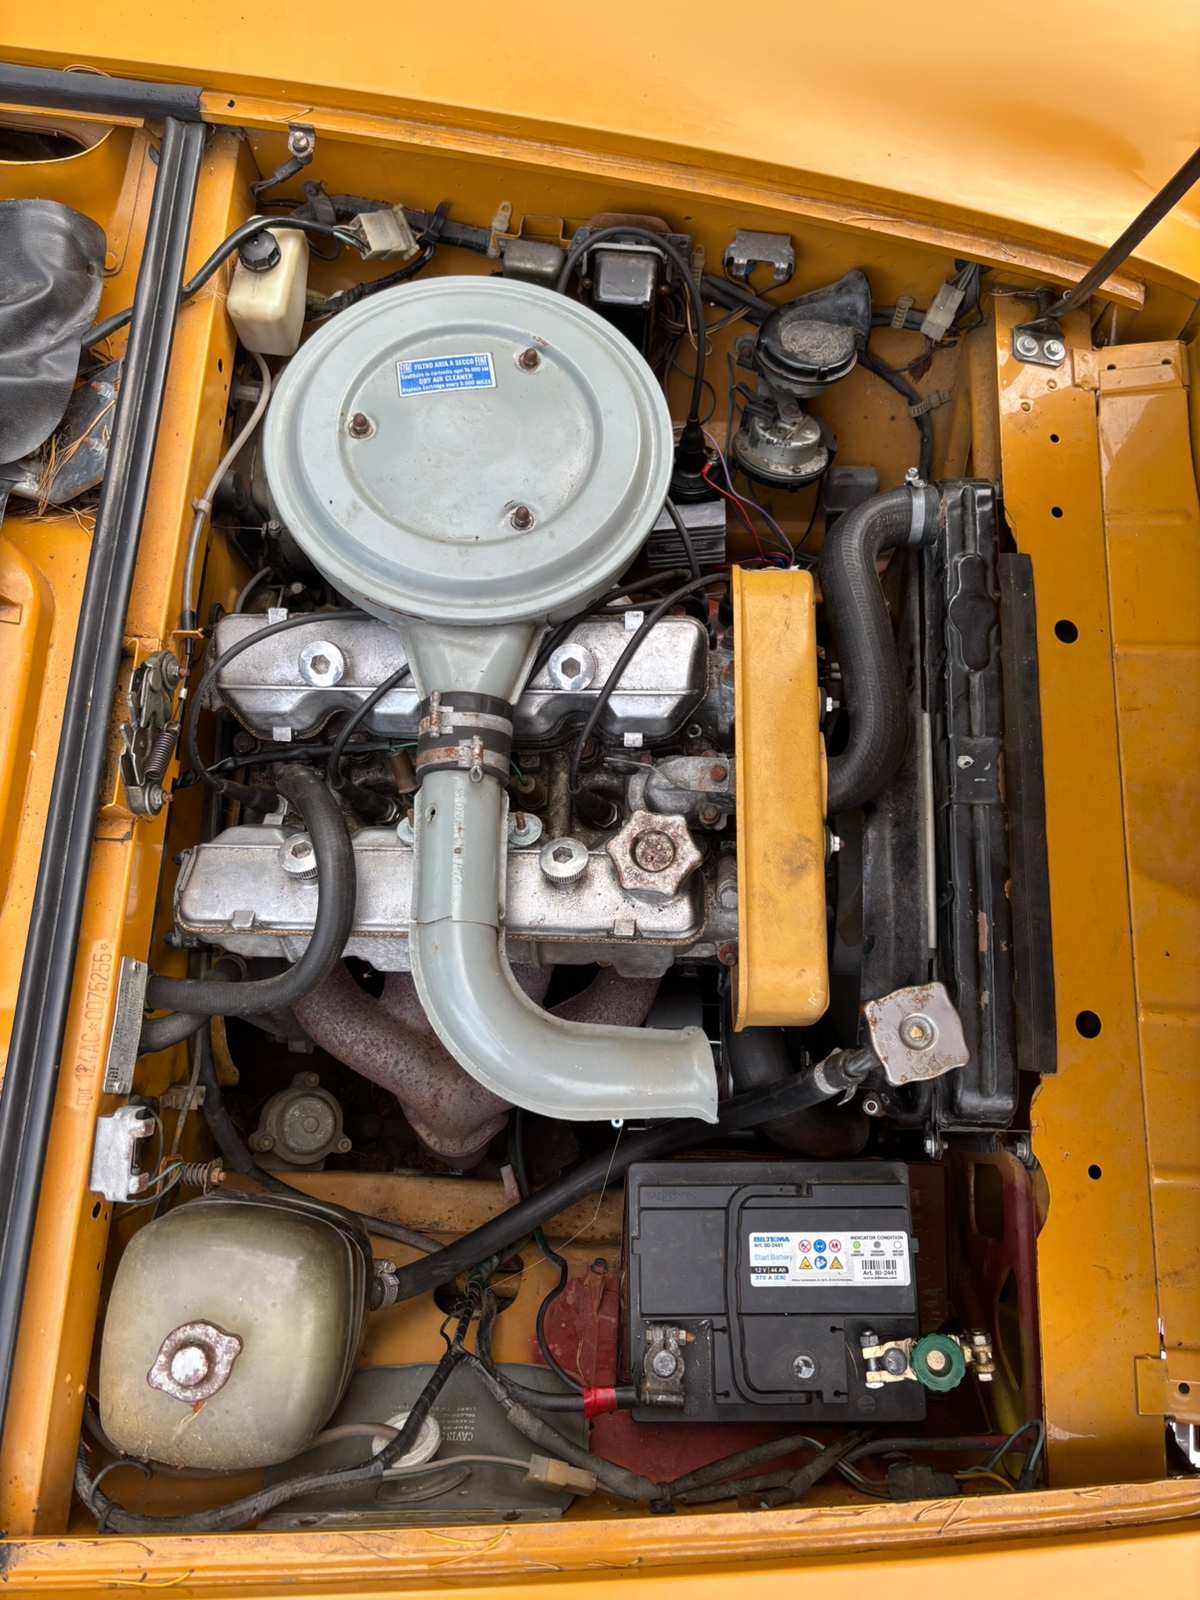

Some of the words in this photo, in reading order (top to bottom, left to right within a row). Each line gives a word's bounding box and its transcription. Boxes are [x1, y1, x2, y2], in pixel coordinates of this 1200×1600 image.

[414, 362, 433, 371] FILTRO
[434, 360, 448, 368] ARIA
[455, 358, 474, 366] SECCO
[445, 373, 474, 382] CLEANER
[754, 1253, 769, 1261] Start
[770, 1253, 793, 1262] Battery
[447, 1431, 474, 1441] CAVIS
